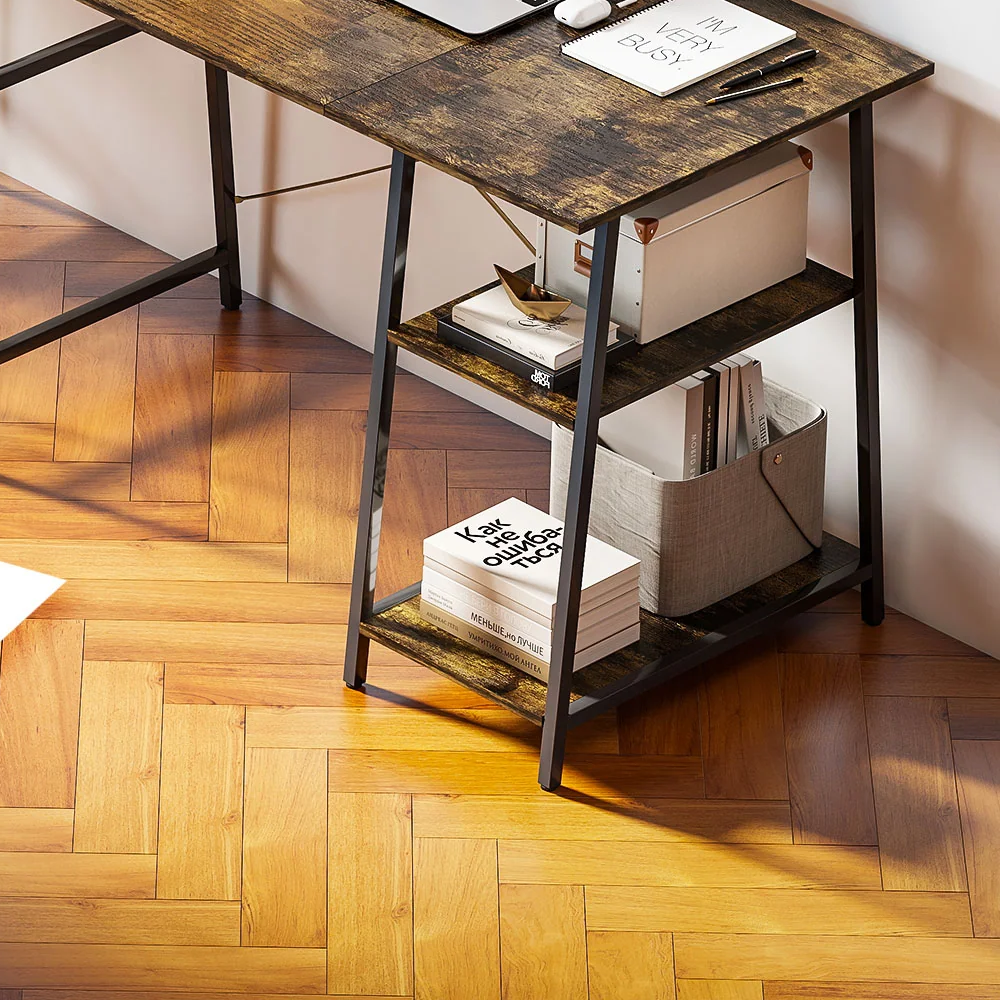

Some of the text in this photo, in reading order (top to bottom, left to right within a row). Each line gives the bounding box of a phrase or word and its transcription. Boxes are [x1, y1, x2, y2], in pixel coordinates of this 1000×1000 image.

[656, 22, 724, 53] VERY
[697, 16, 738, 36] I'M
[617, 33, 693, 71] BUSY.
[454, 518, 512, 544] Как
[485, 530, 520, 549] не
[483, 526, 564, 567] ошиба-
[510, 542, 563, 568] ться
[517, 635, 544, 657] ЛУЧШЕ
[520, 658, 542, 674] АНГЕЛ
